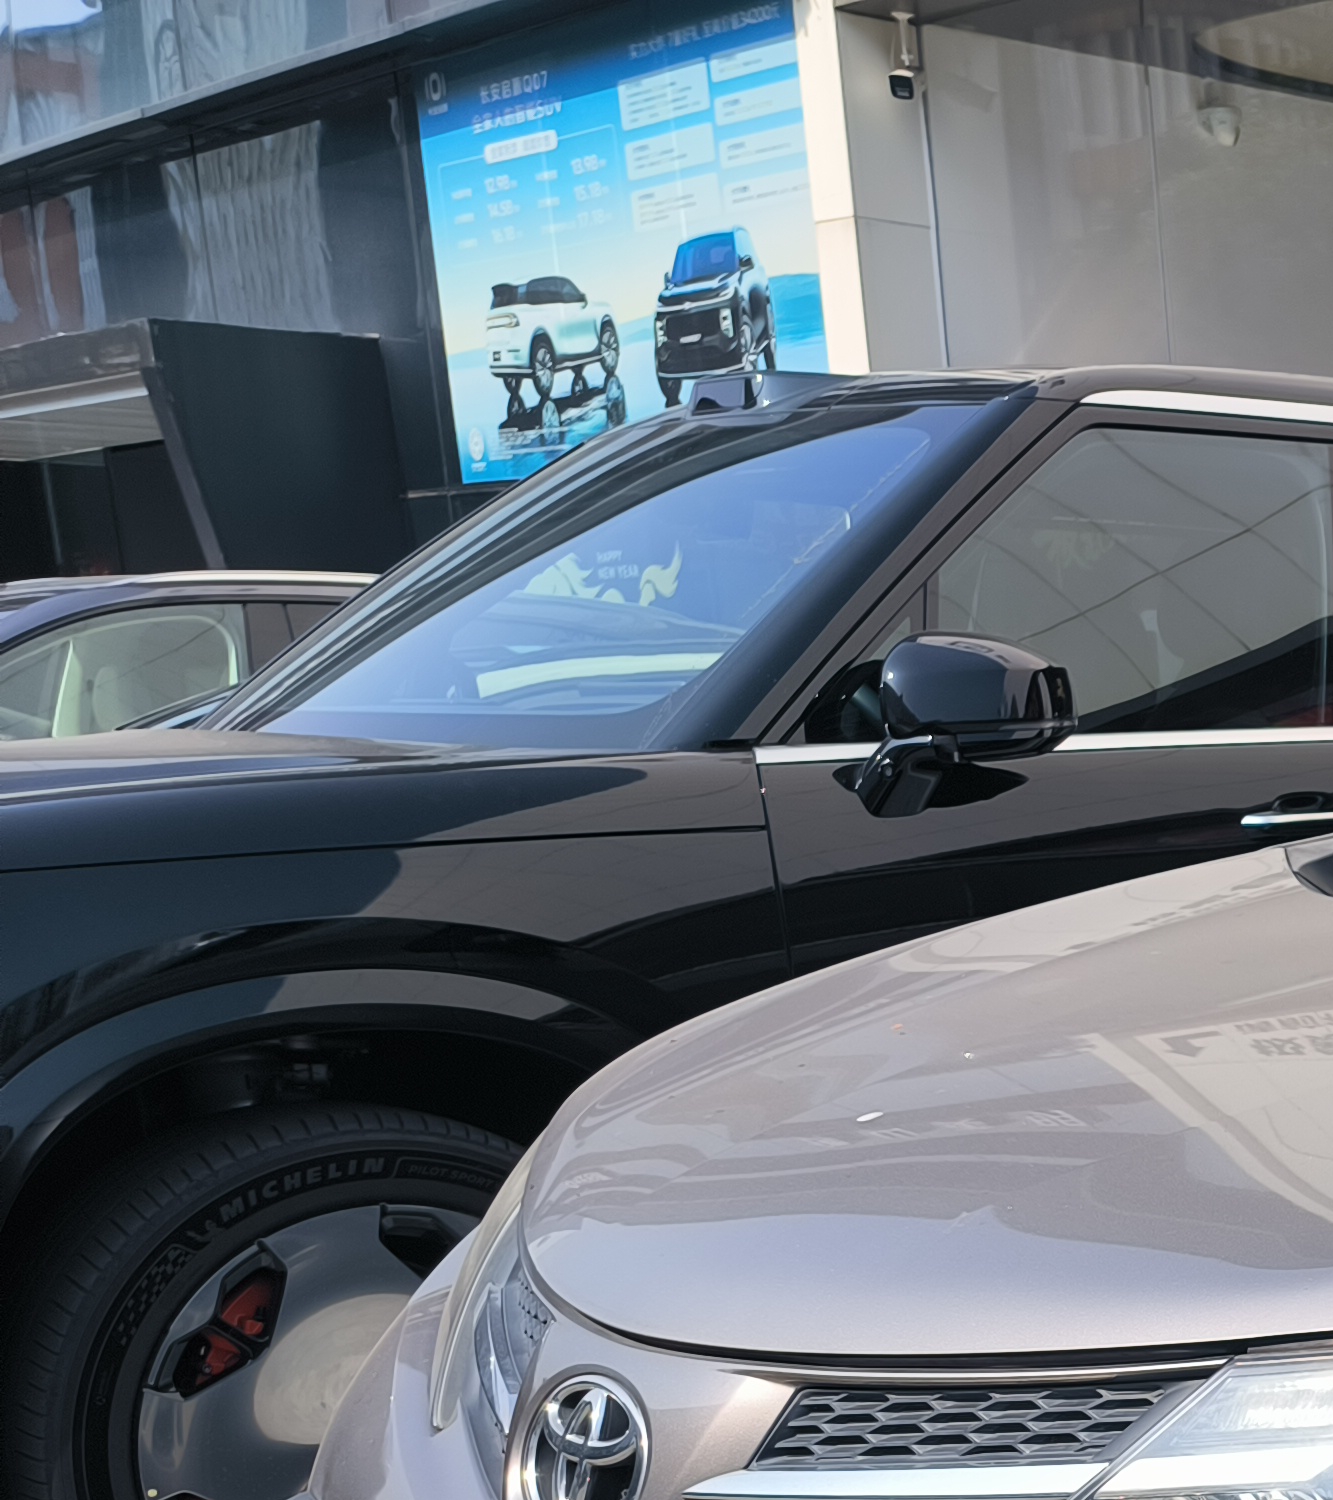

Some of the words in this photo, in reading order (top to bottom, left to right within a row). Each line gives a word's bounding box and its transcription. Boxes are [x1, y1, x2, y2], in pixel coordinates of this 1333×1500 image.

[219, 1156, 386, 1222] MICHELIN
[407, 1163, 449, 1177] PILOT
[450, 1170, 495, 1189] SPORT
